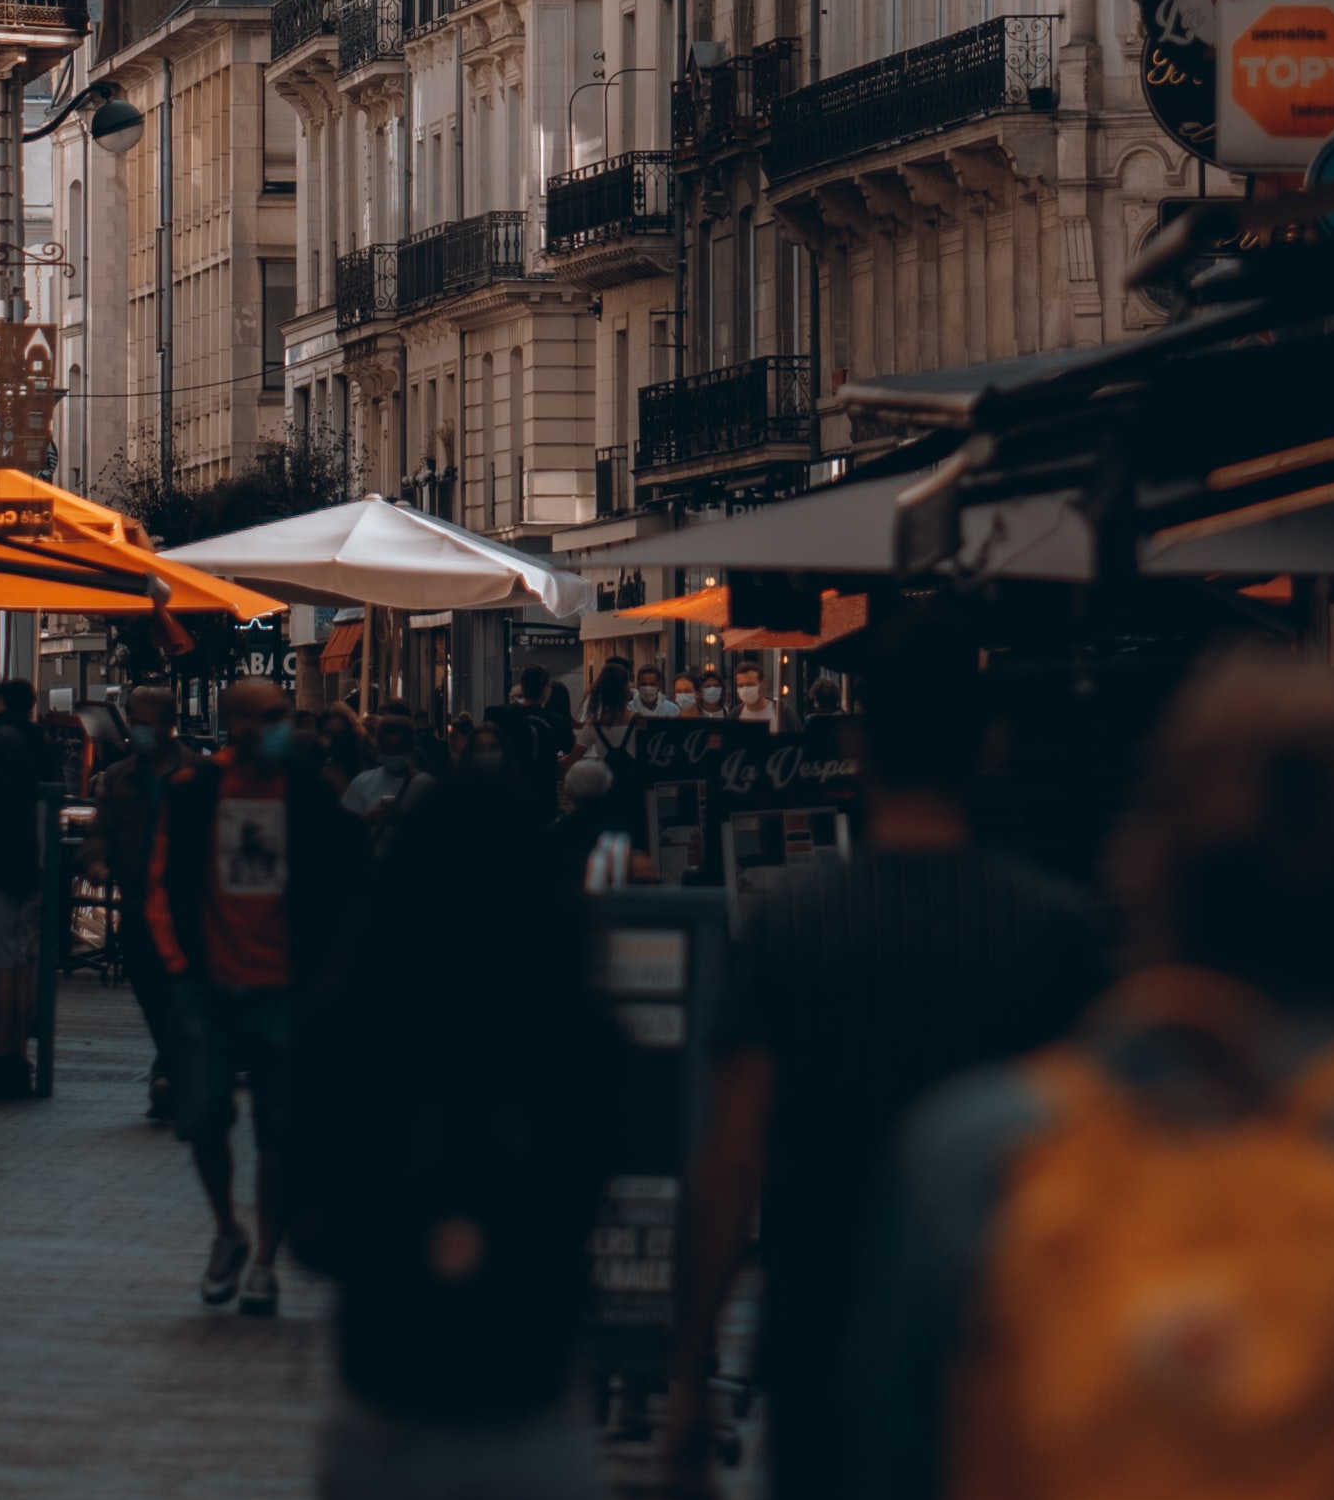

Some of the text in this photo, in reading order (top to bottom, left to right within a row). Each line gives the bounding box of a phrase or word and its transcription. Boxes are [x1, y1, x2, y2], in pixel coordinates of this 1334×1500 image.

[1251, 26, 1327, 41] semelles
[531, 635, 565, 645] Renova
[720, 746, 859, 793] La Vespa
